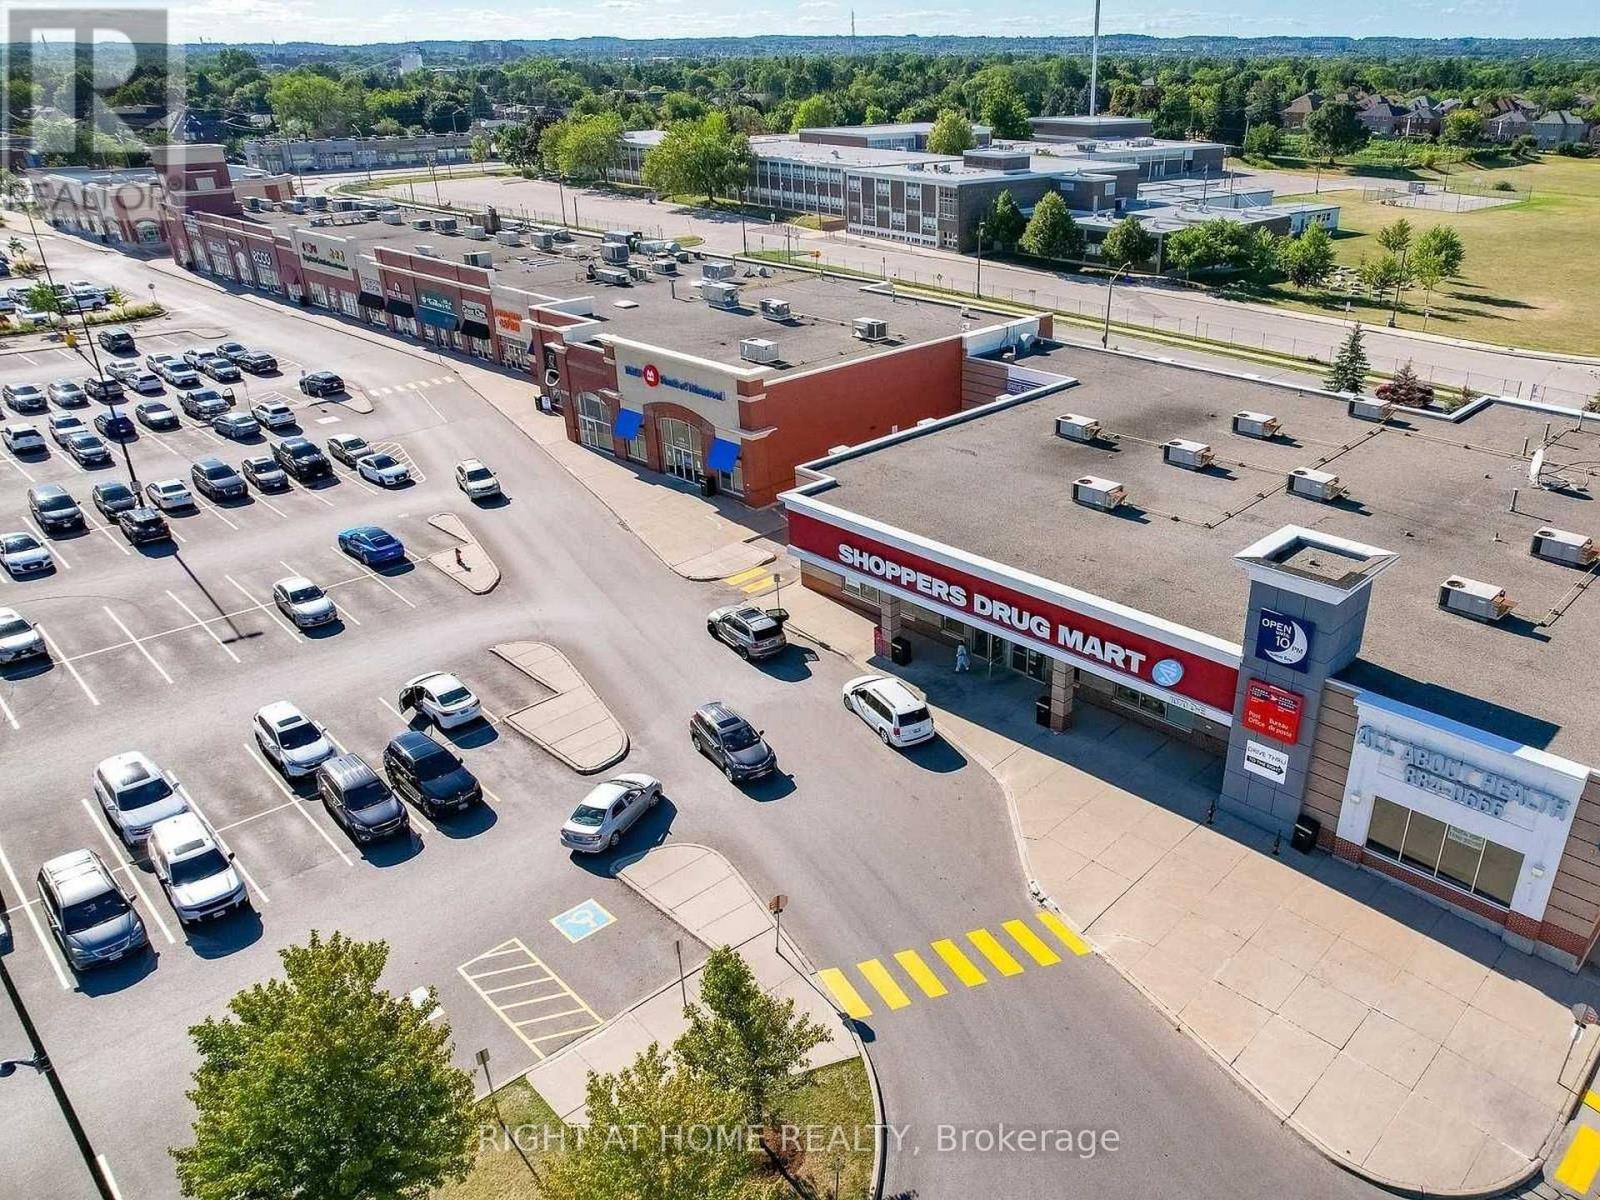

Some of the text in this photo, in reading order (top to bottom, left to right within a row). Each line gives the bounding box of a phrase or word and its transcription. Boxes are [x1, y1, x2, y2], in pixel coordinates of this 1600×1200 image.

[838, 543, 1147, 674] SHOPPERS DRUG MART
[1262, 618, 1292, 635] OPEN
[1275, 636, 1290, 649] 10
